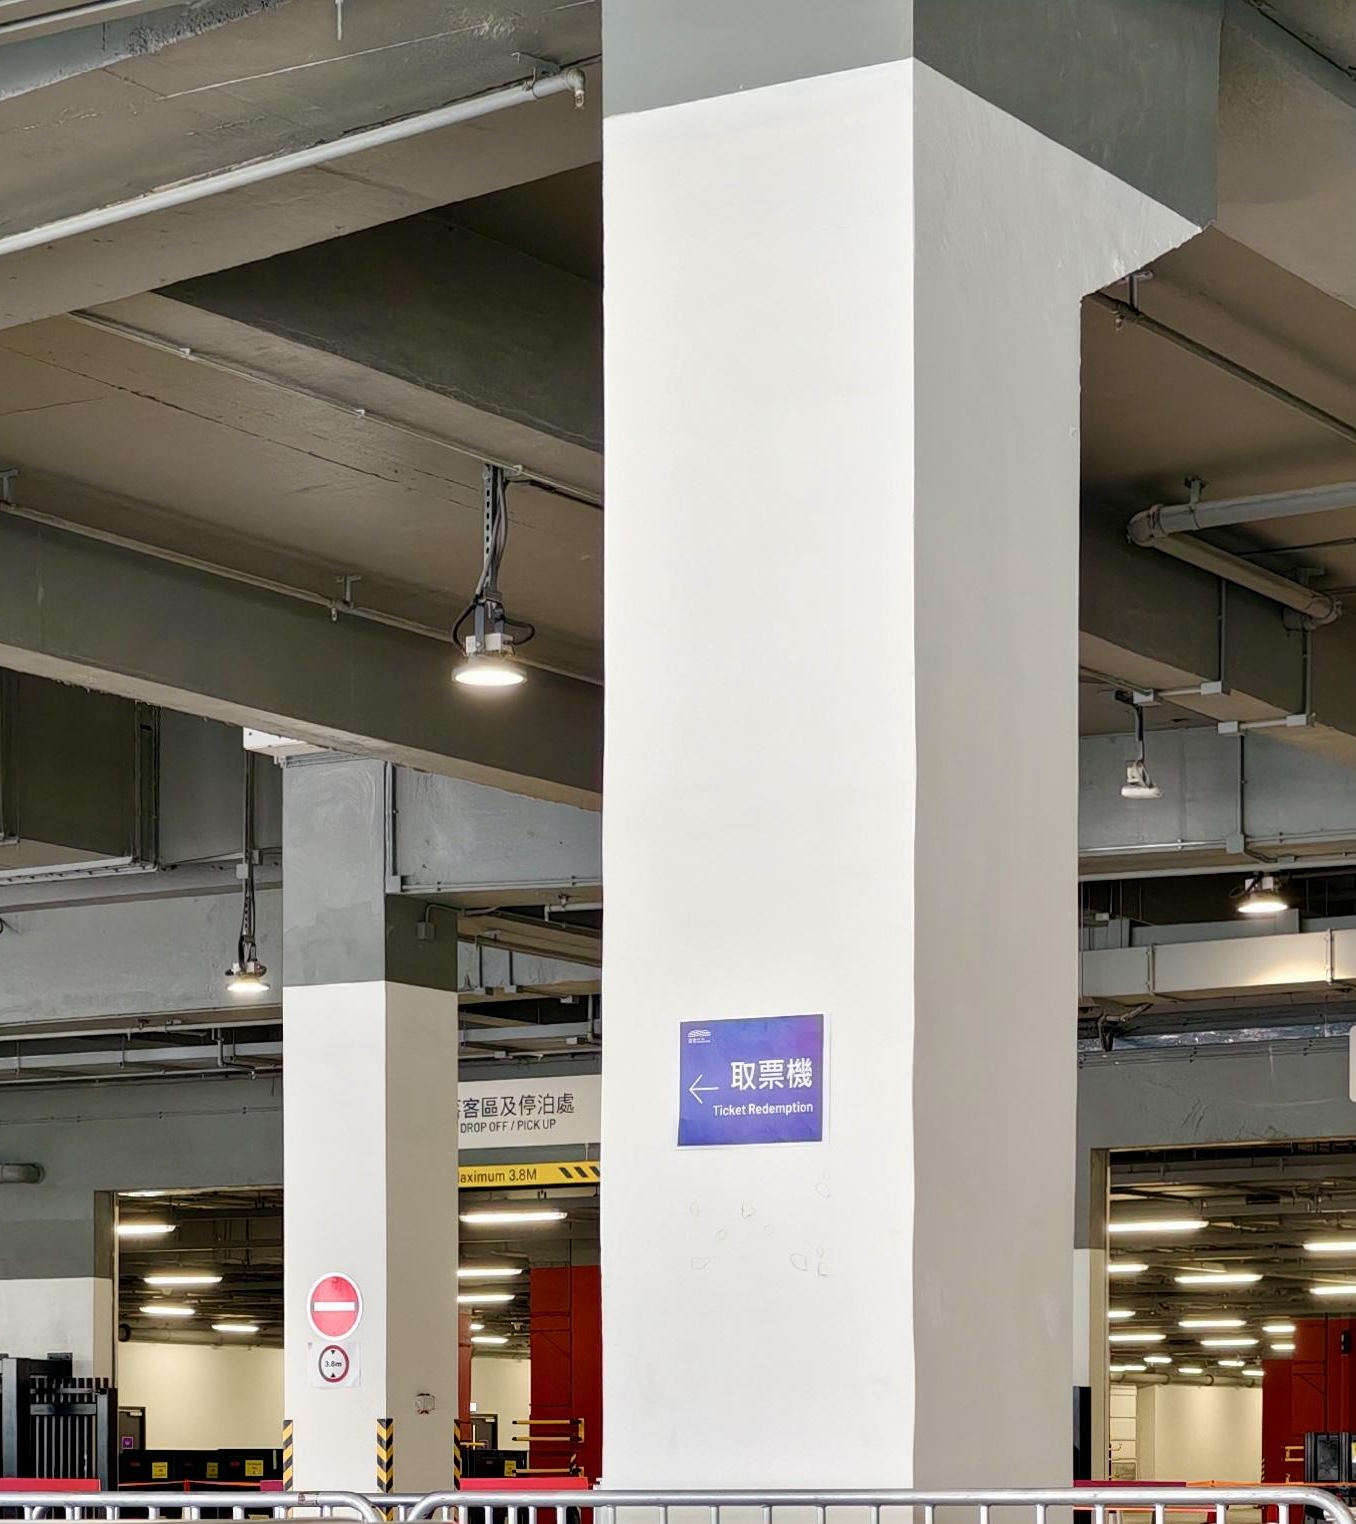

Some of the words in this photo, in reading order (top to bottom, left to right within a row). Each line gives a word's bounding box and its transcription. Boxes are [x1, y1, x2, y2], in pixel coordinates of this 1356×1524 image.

[730, 1058, 813, 1091] 取票機
[457, 1092, 575, 1119] 客區及停泊處
[712, 1104, 747, 1117] Ticket
[748, 1102, 814, 1116] Redemption
[460, 1121, 487, 1134] DROP
[489, 1120, 508, 1132] OFF
[510, 1120, 515, 1131] /
[517, 1119, 540, 1131] PICK
[542, 1118, 557, 1130] UP
[457, 1170, 506, 1183] aximum
[508, 1168, 537, 1182] 3.8M
[325, 1360, 342, 1368] 3.8m
